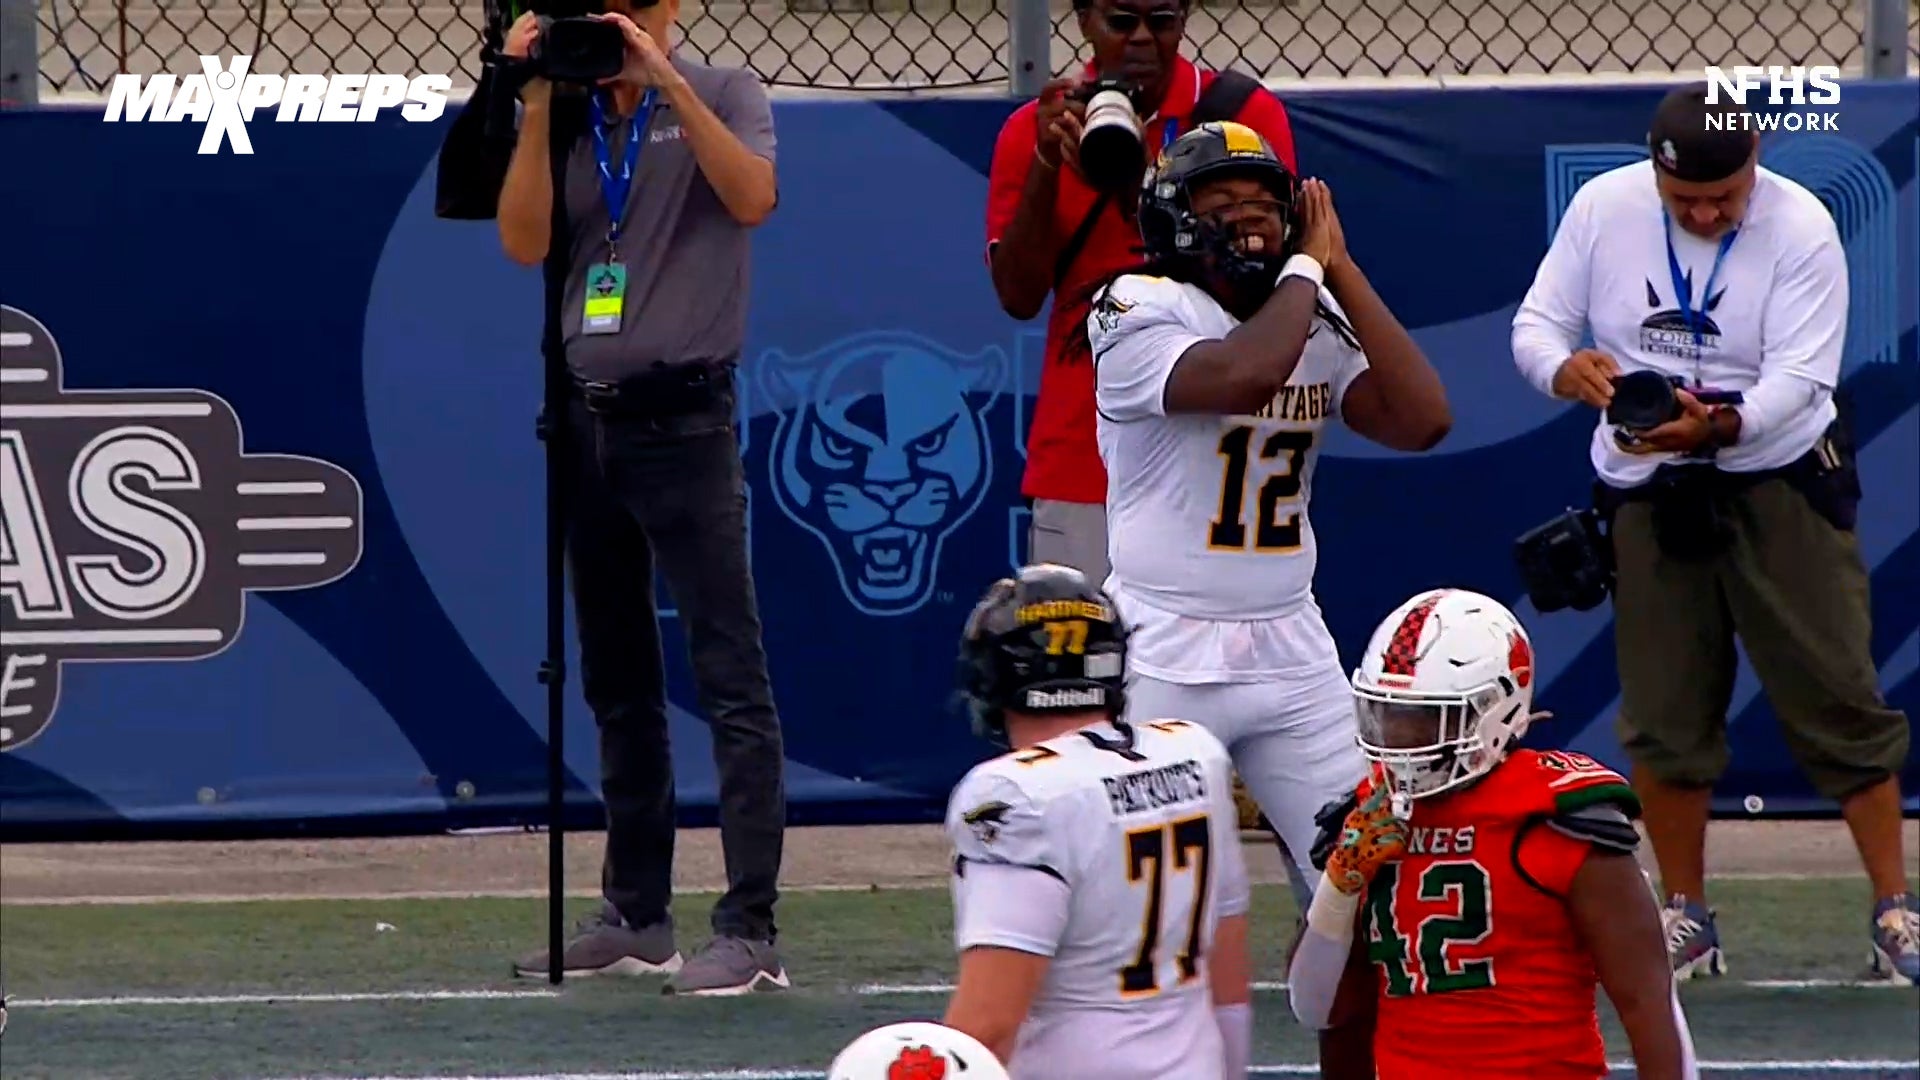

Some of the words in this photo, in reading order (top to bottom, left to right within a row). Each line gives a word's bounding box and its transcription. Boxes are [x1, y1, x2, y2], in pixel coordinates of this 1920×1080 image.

[1208, 425, 1313, 554] 12
[1043, 620, 1089, 655] 77
[1405, 825, 1476, 854] NES
[1119, 812, 1210, 999] 77
[1361, 859, 1497, 997] 42
